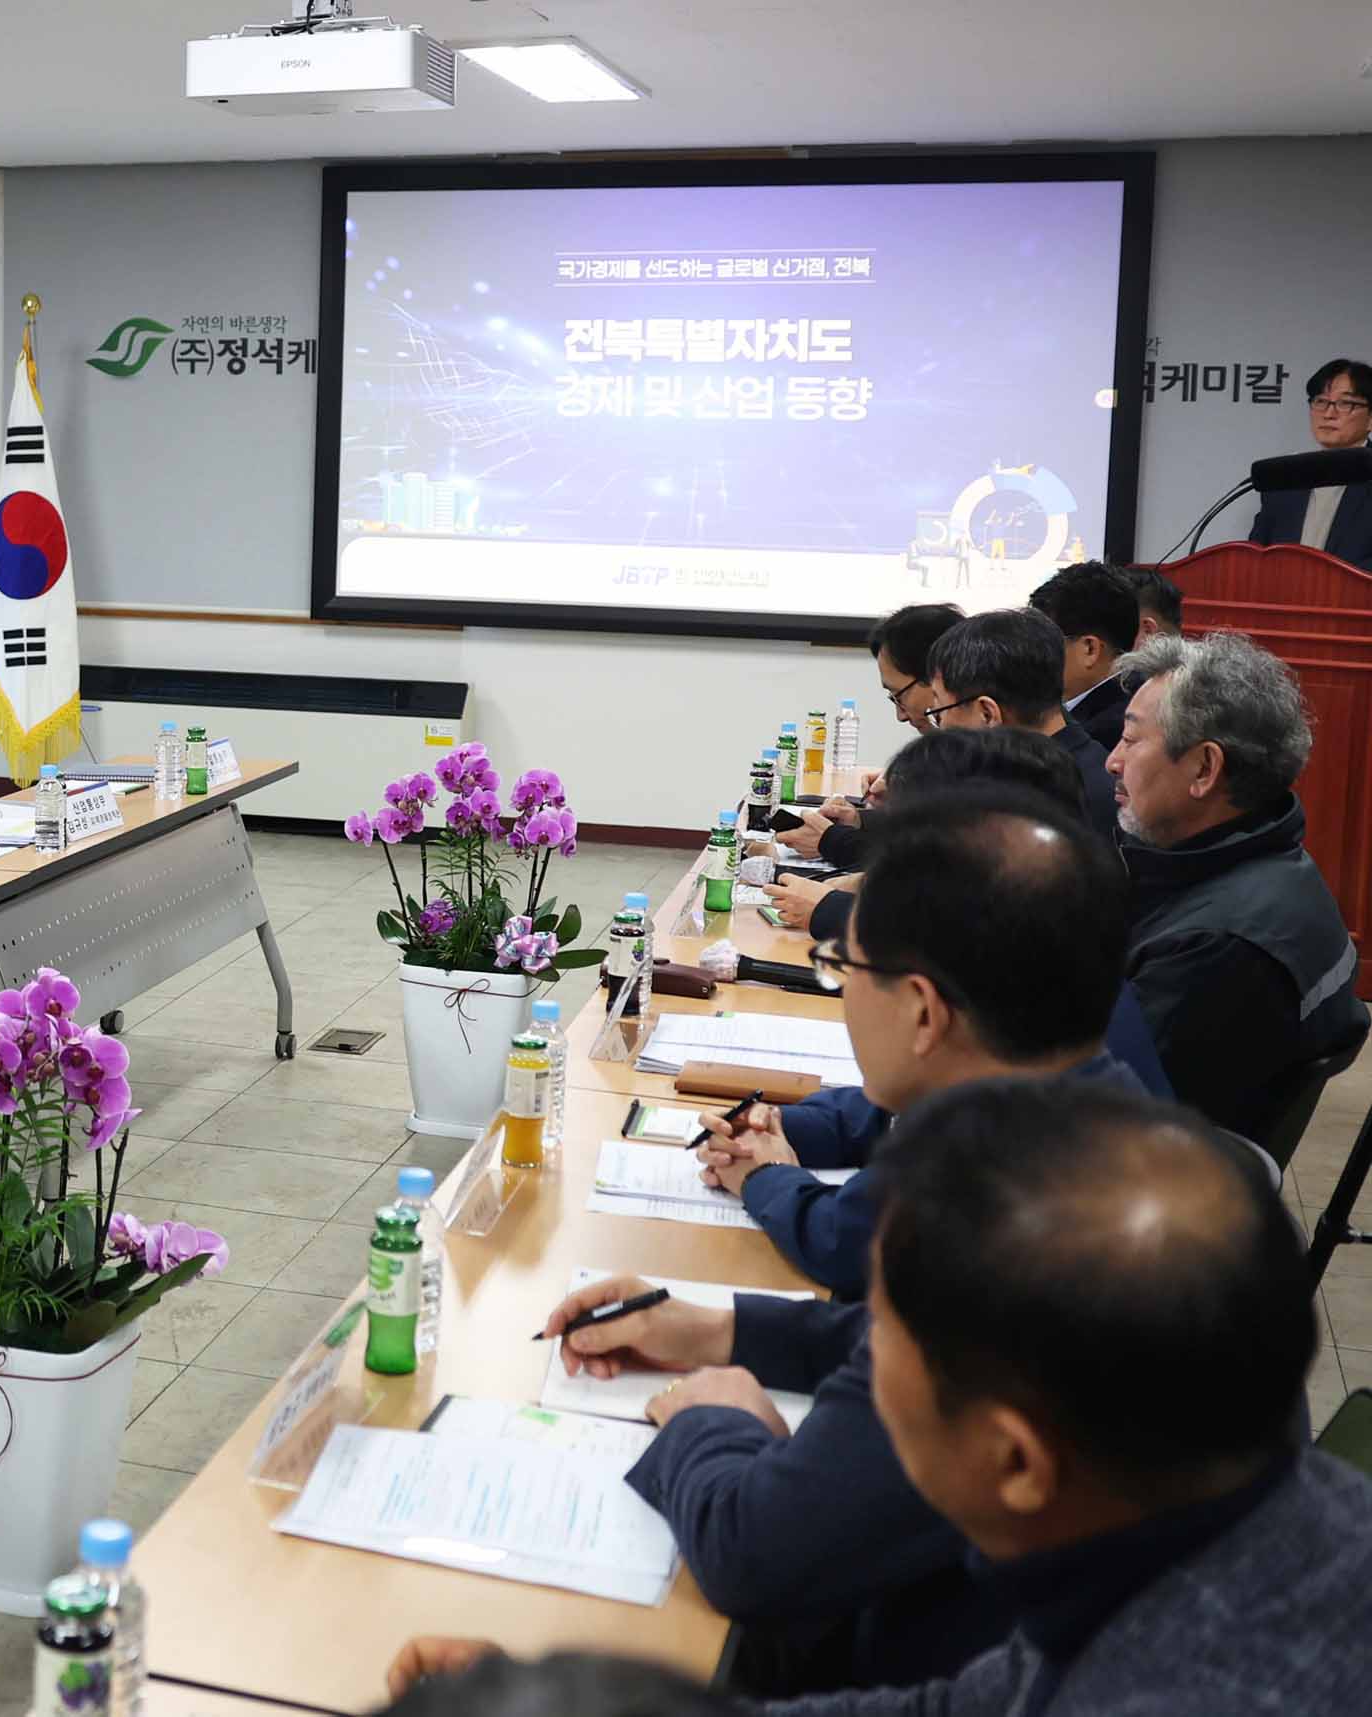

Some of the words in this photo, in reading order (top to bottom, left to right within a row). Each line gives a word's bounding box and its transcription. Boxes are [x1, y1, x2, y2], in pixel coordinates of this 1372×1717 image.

[281, 59, 311, 69] EPSON
[557, 259, 641, 280] 국가경제를
[645, 258, 713, 279] 선도하는
[717, 258, 768, 278] 글로벌
[834, 257, 871, 277] 전북
[181, 315, 224, 334] 자연의
[229, 314, 287, 334] 바른생각
[564, 319, 852, 362] 전북특별자치도
[555, 376, 634, 418] 경제
[643, 376, 683, 418] 및
[691, 376, 774, 420] 산업
[786, 376, 874, 422] 동향
[72, 795, 106, 815] 산업통상부
